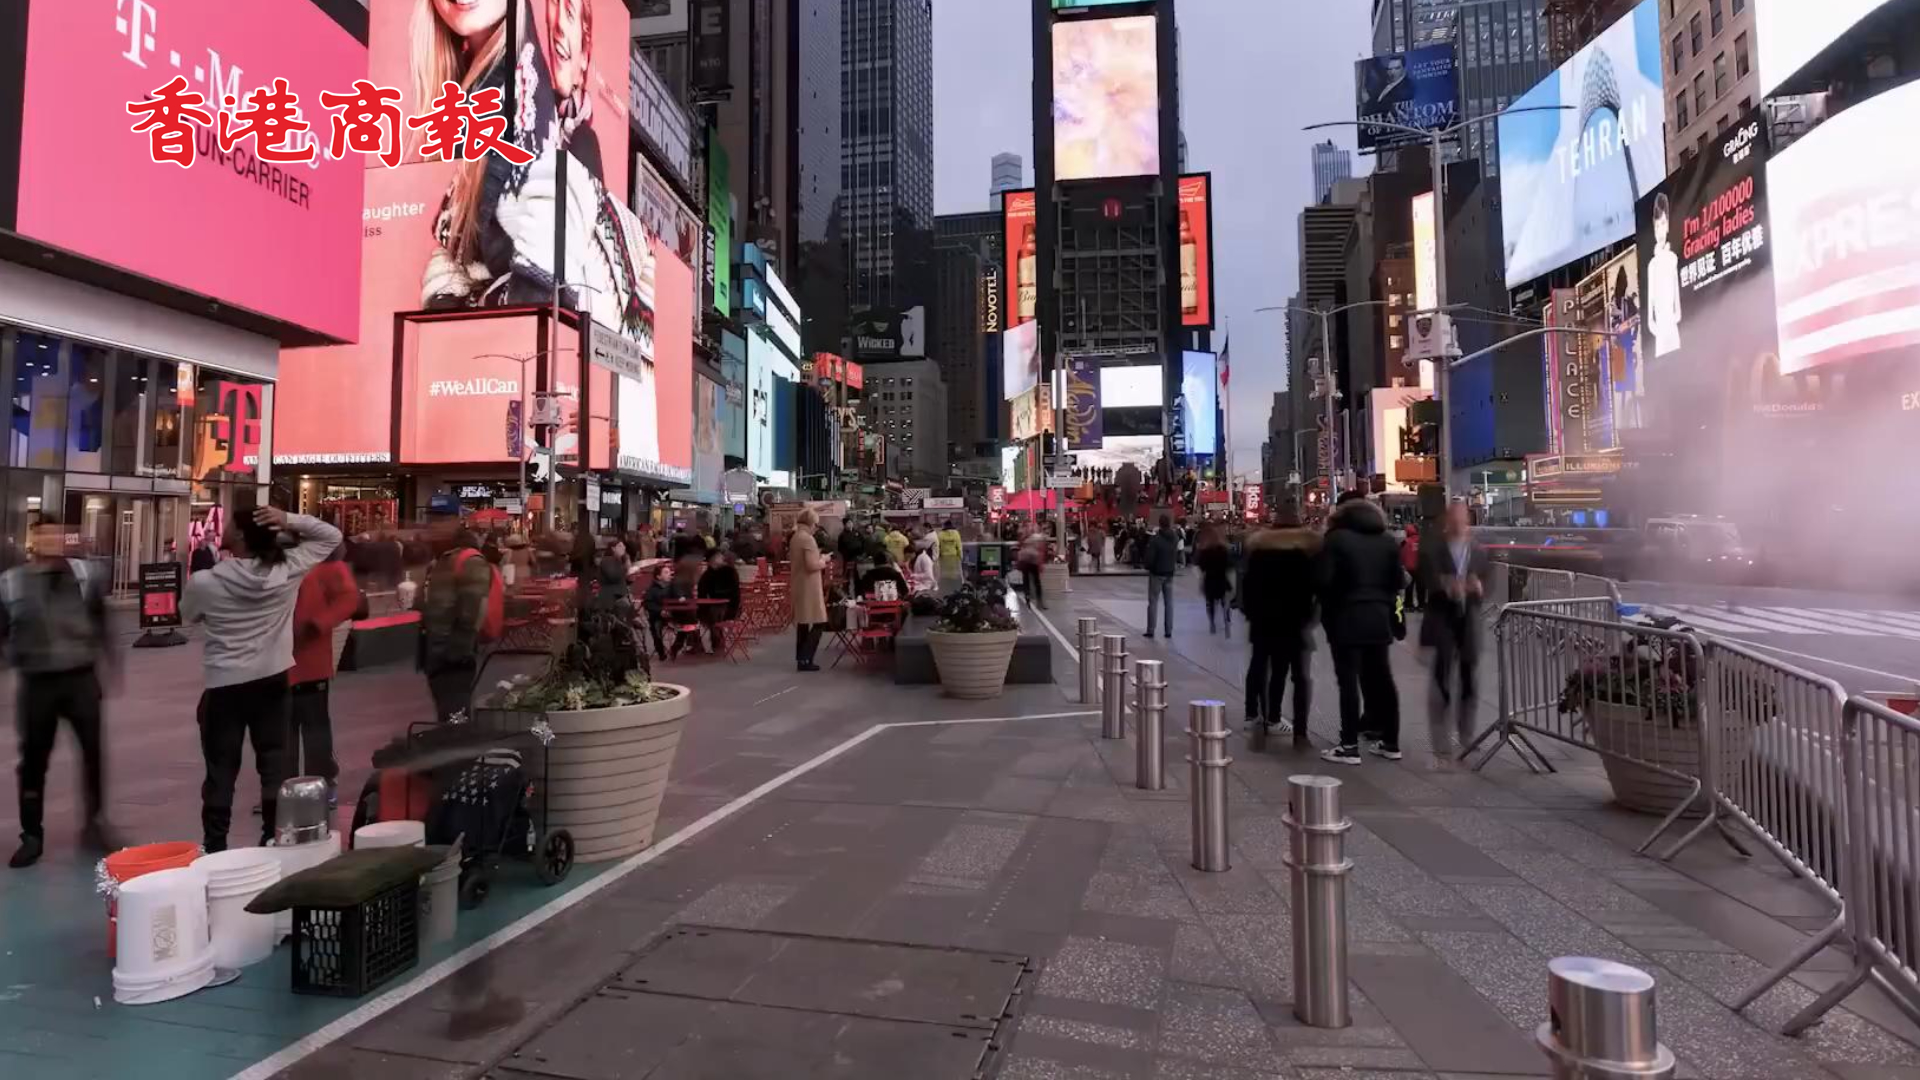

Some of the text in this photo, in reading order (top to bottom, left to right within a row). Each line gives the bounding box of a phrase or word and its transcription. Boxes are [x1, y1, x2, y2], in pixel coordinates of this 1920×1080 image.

[1360, 100, 1454, 129] PHANTOM
[1556, 95, 1646, 184] TEHRAN
[1680, 250, 1716, 287] 世界见证
[1721, 224, 1763, 266] 百年优雅
[1684, 217, 1700, 239] I'm
[1684, 205, 1754, 259] Gracing ladies
[986, 271, 997, 333] NOVOTEL
[429, 378, 518, 396] #WeAllCan
[1562, 299, 1580, 418] PALACE
